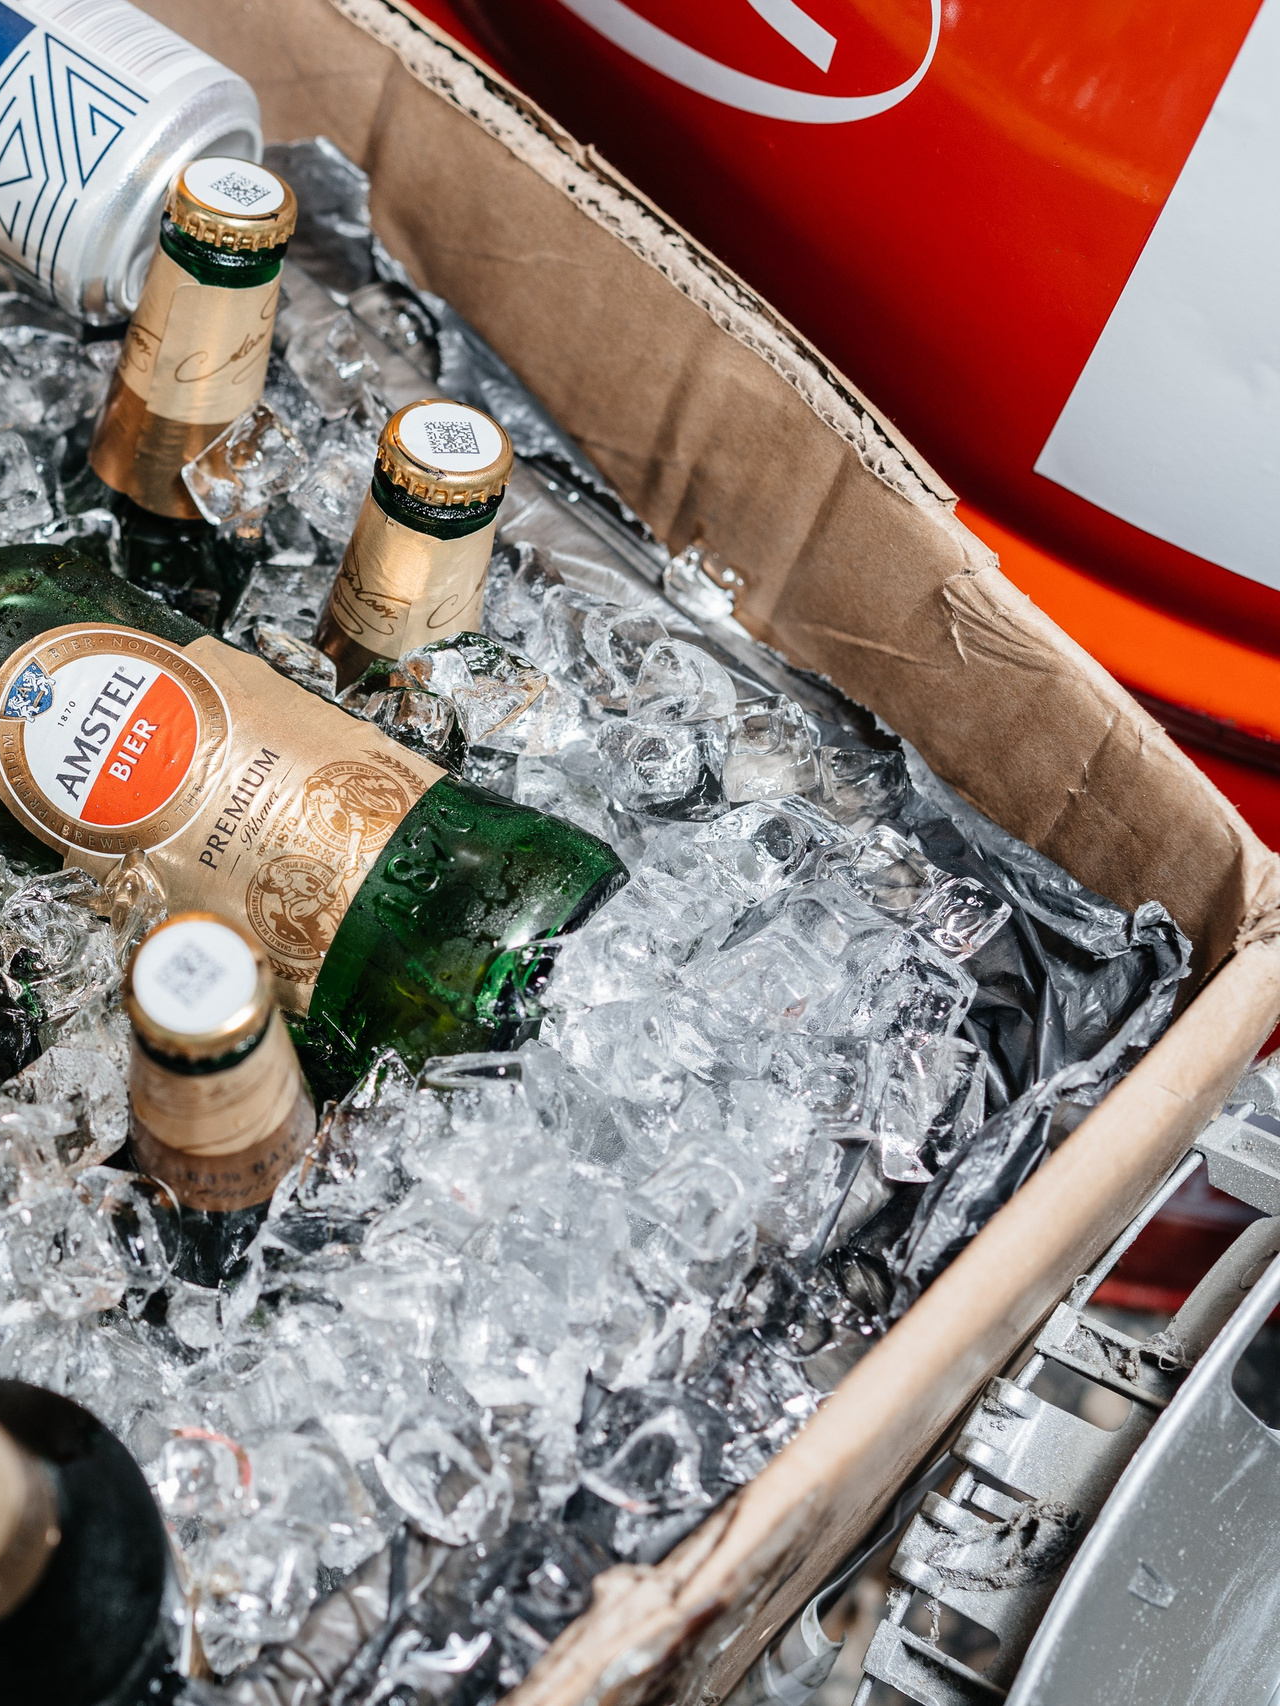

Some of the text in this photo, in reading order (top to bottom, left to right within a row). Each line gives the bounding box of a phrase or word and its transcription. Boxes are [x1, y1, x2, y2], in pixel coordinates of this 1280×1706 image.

[111, 637, 211, 697] TRADITION
[1, 636, 96, 822] PREMIUM BIER
[55, 669, 146, 802] AMSTEL
[57, 700, 77, 727] 1870
[108, 717, 160, 783] BIER
[147, 818, 171, 841] TO
[176, 783, 205, 818] THE
[198, 747, 281, 871] PREMIUM
[240, 790, 280, 851] Pilsener
[256, 797, 295, 858] TOGETHER SINCE
[60, 824, 141, 850] BREWED
[273, 816, 299, 850] 1870
